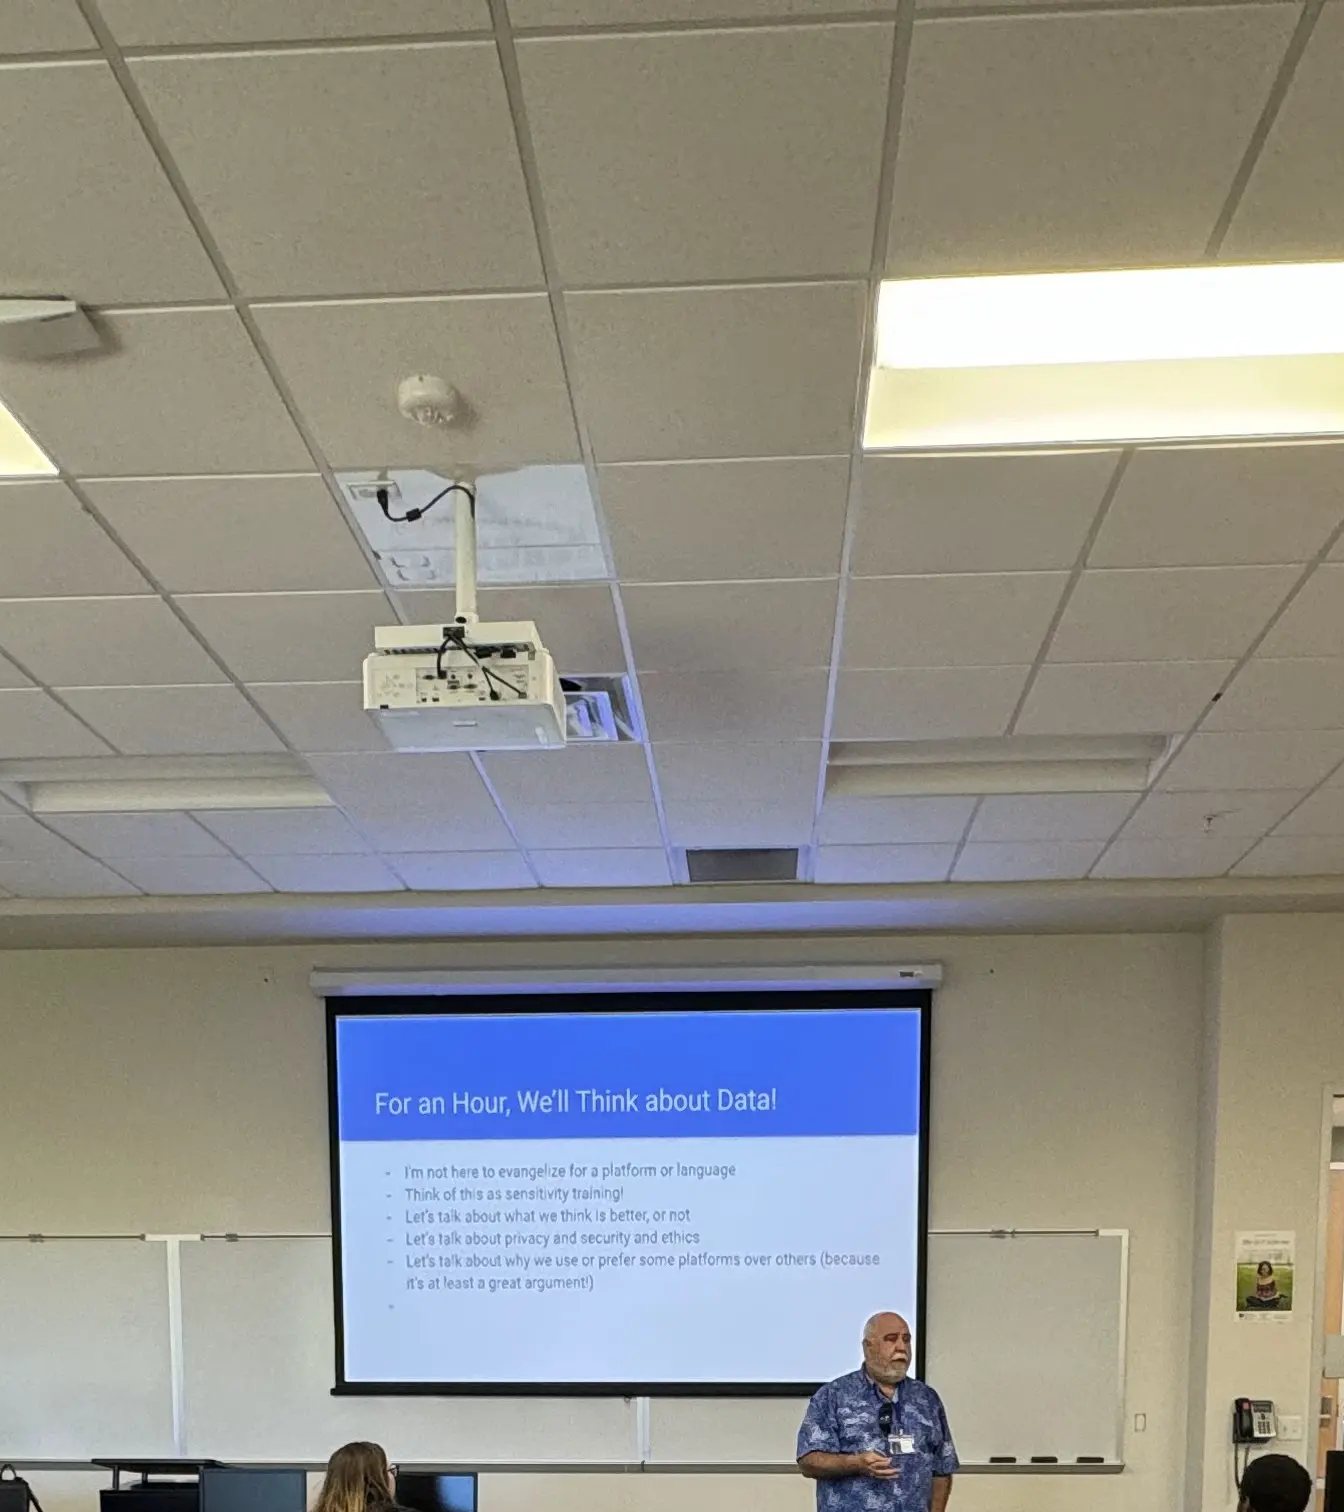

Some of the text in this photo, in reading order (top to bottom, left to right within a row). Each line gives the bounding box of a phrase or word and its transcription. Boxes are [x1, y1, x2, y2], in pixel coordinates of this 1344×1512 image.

[375, 1087, 776, 1117] For an Hour, We'll Think about Data!
[404, 1162, 736, 1181] I'm not here to evangelize for a platform or language
[405, 1186, 624, 1204] Think of this as sensitivity training!
[405, 1208, 690, 1224] Let's talk about what we think is better, or not
[406, 1230, 700, 1248] Let's talk about privacy and security and ethics
[406, 1250, 881, 1270] Let's talk about why we use or prefer some platforms over others (because
[406, 1276, 424, 1290] it's
[428, 1277, 440, 1290] at
[443, 1276, 474, 1289] least
[477, 1279, 485, 1289] a
[488, 1276, 521, 1292] great
